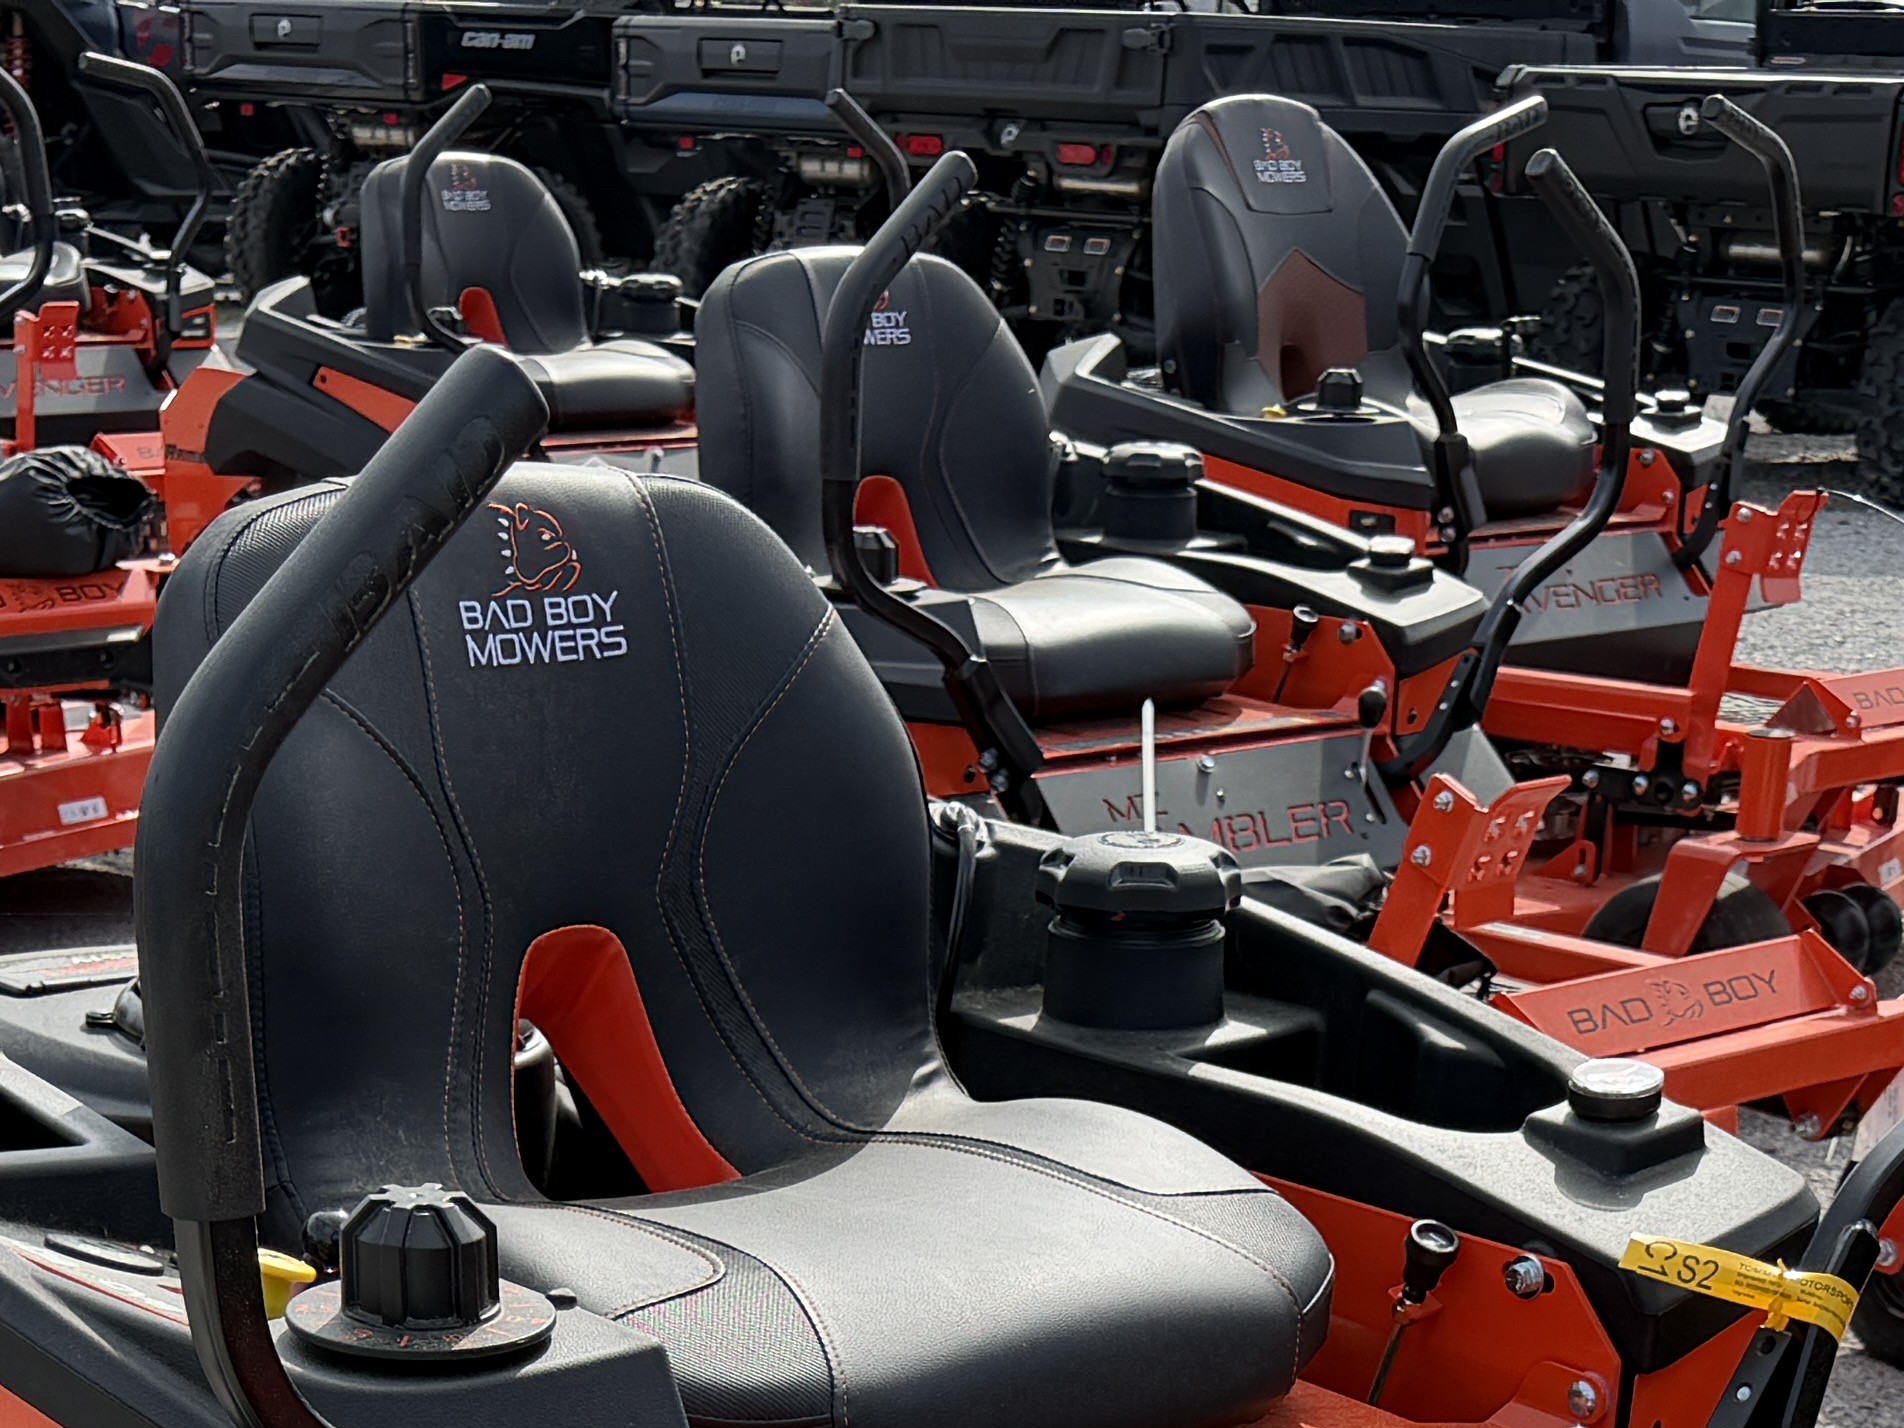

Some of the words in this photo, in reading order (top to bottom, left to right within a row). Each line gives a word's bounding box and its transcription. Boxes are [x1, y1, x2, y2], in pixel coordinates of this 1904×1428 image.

[871, 311, 907, 327] BOY
[459, 600, 533, 630] BAD
[543, 590, 618, 626] BOY
[465, 625, 628, 667] MOWERS
[1566, 996, 1656, 1036] BAD
[1701, 968, 1781, 1009] BOY
